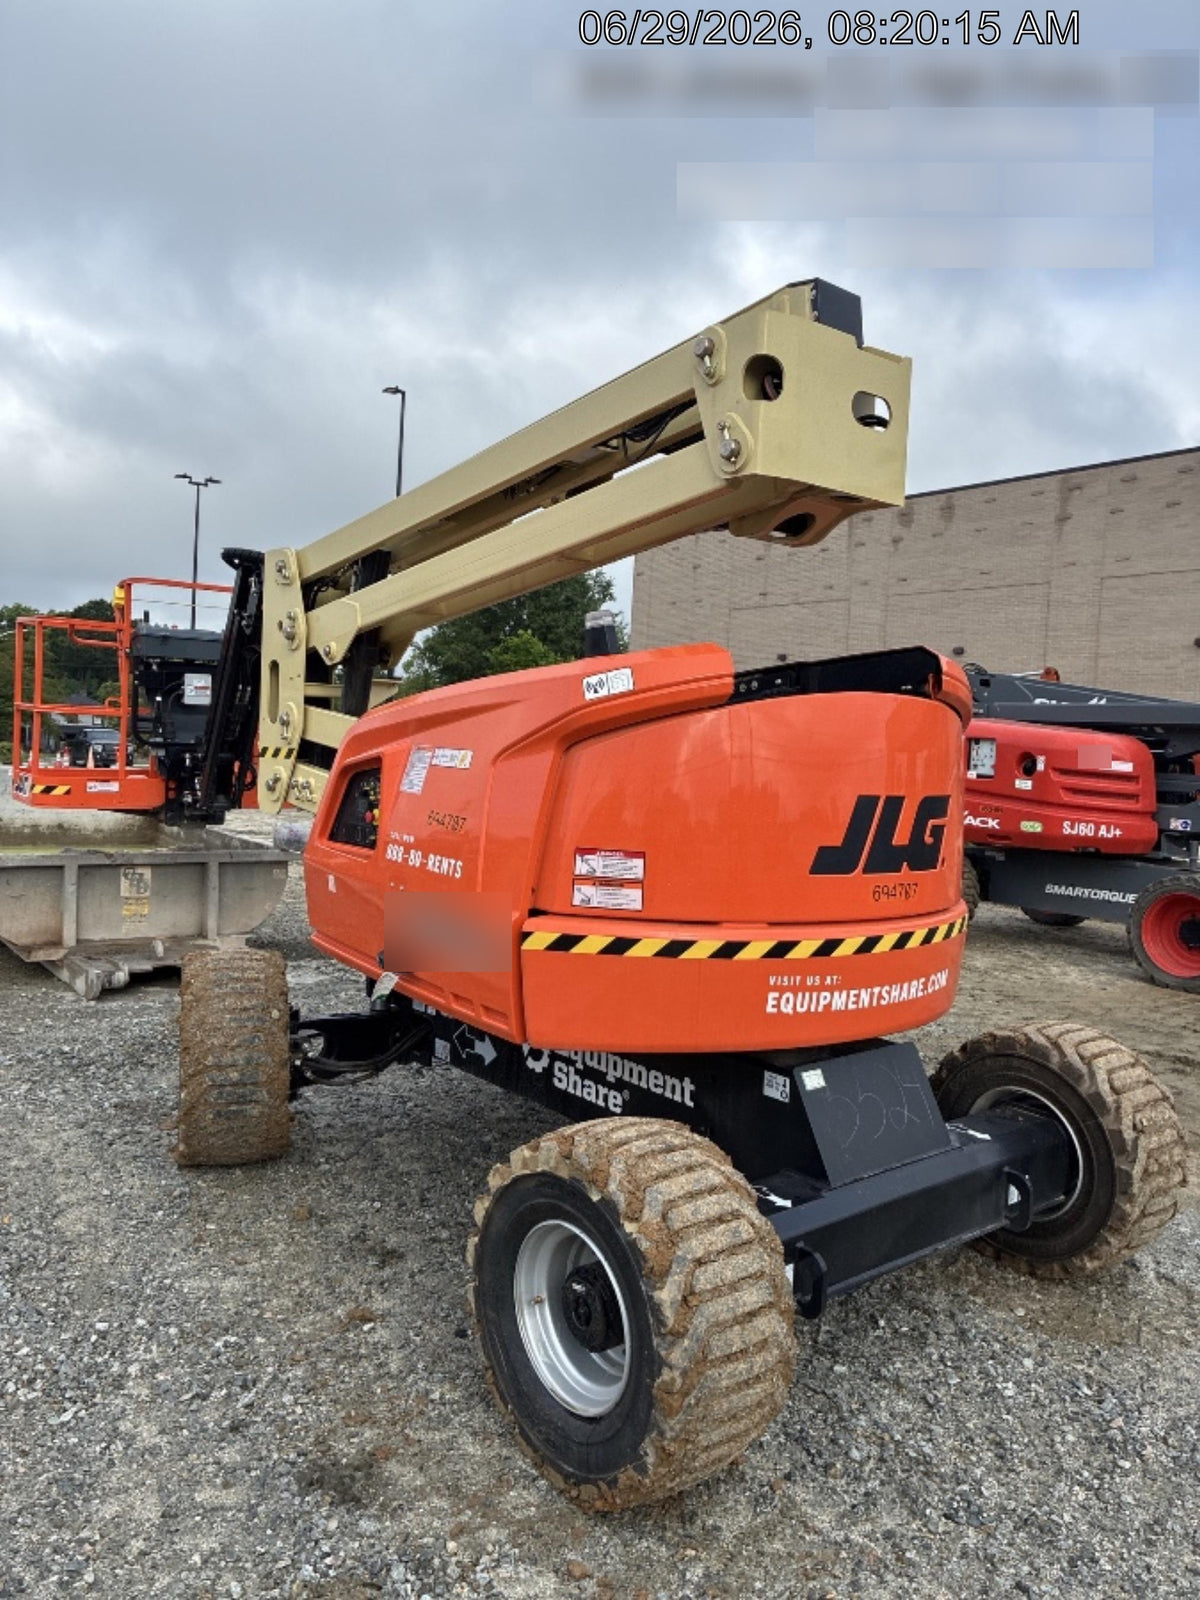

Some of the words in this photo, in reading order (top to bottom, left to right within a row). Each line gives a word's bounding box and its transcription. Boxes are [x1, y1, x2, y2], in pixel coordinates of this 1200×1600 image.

[963, 810, 1001, 830] ACK
[1062, 820, 1095, 837] SJ60
[808, 794, 951, 876] JLG
[1044, 882, 1139, 905] SMARTORQUE
[765, 968, 950, 1016] EQUIPMENTSHARE.COM
[768, 975, 801, 986] VISIT
[806, 975, 820, 986] US
[555, 1049, 696, 1109] quipment
